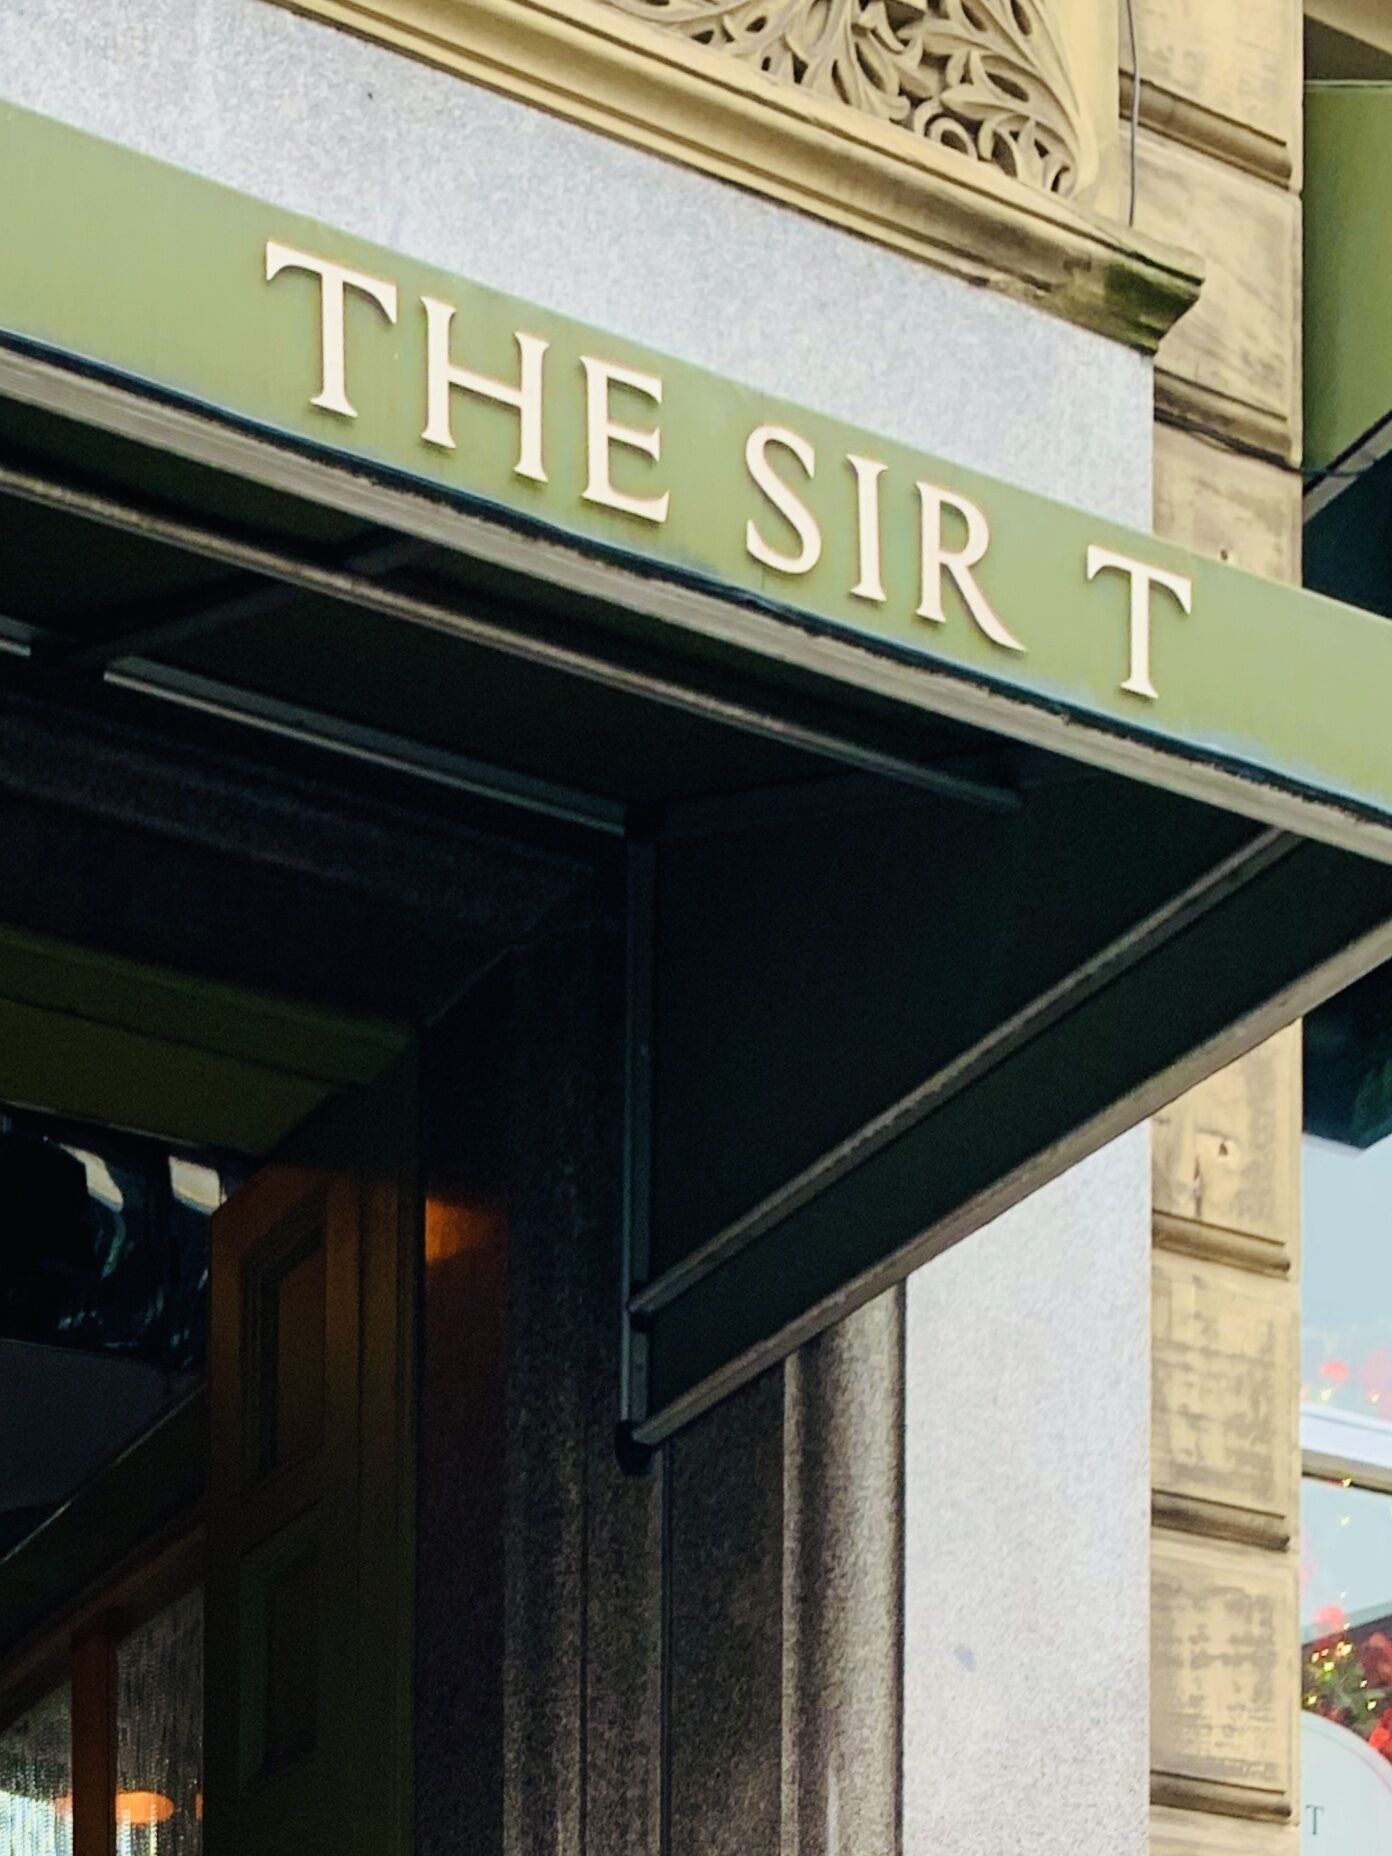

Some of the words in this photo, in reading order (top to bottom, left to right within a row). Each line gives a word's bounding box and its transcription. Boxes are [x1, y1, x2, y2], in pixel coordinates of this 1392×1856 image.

[265, 241, 669, 523] THE
[746, 424, 1027, 652] SIR
[1087, 543, 1193, 698] T
